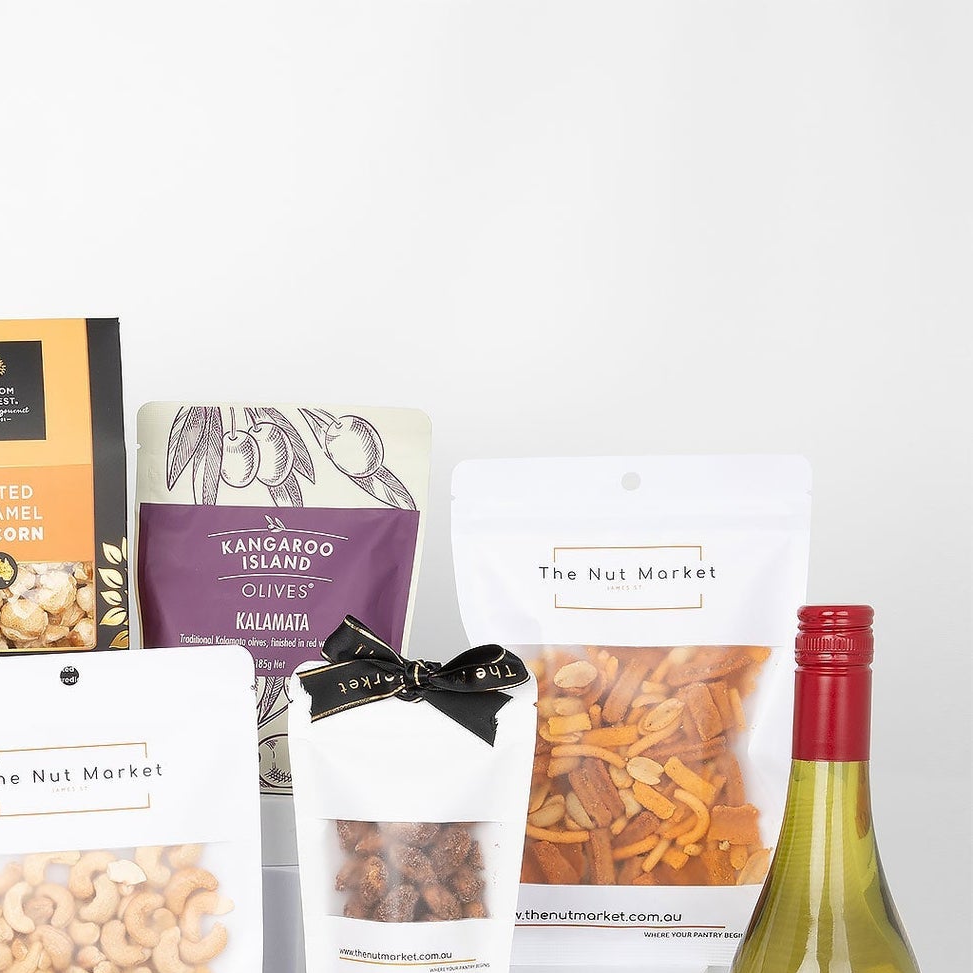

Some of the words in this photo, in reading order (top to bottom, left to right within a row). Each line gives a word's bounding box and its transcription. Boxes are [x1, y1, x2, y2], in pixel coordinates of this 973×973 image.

[221, 537, 334, 557] KANGAROO
[242, 555, 311, 571] ISLAND
[538, 566, 577, 581] The
[589, 567, 626, 581] Nut
[638, 565, 716, 580] Market
[236, 612, 309, 631] KALAMATA
[180, 634, 214, 645] Traditional
[215, 636, 246, 646] Kalamata
[271, 637, 296, 648] finished
[298, 638, 305, 648] in
[306, 638, 317, 648] red
[32, 767, 72, 783] Nut
[83, 763, 163, 781] Market
[339, 948, 452, 962] www.thenutmarket.com.au
